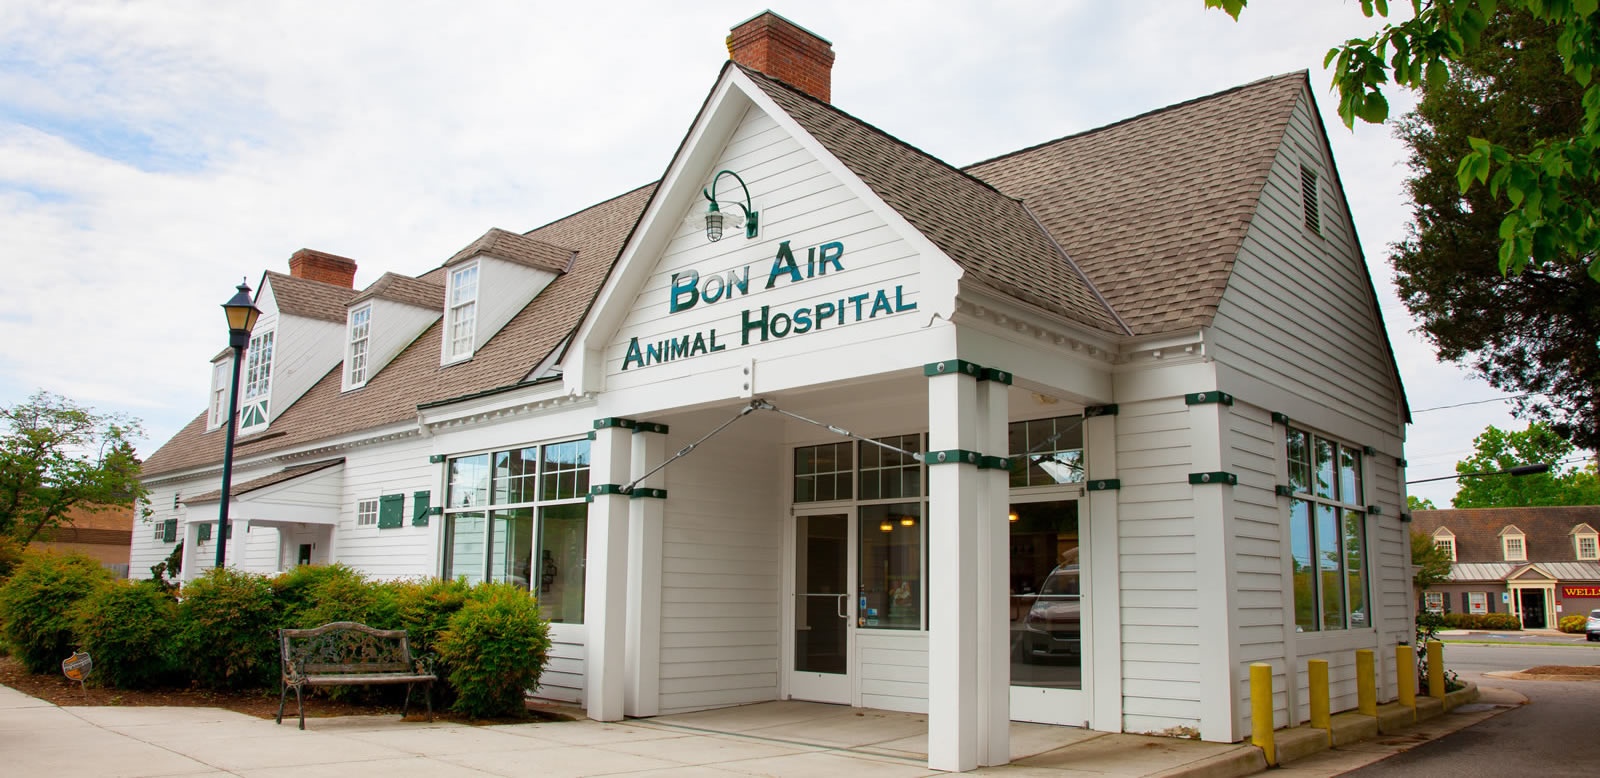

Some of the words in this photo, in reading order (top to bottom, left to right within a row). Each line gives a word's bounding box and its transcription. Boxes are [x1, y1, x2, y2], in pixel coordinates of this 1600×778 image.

[669, 266, 750, 314] BON
[765, 240, 844, 289] AIR
[621, 329, 726, 371] ANIMAL
[741, 285, 917, 346] HOSPITAL
